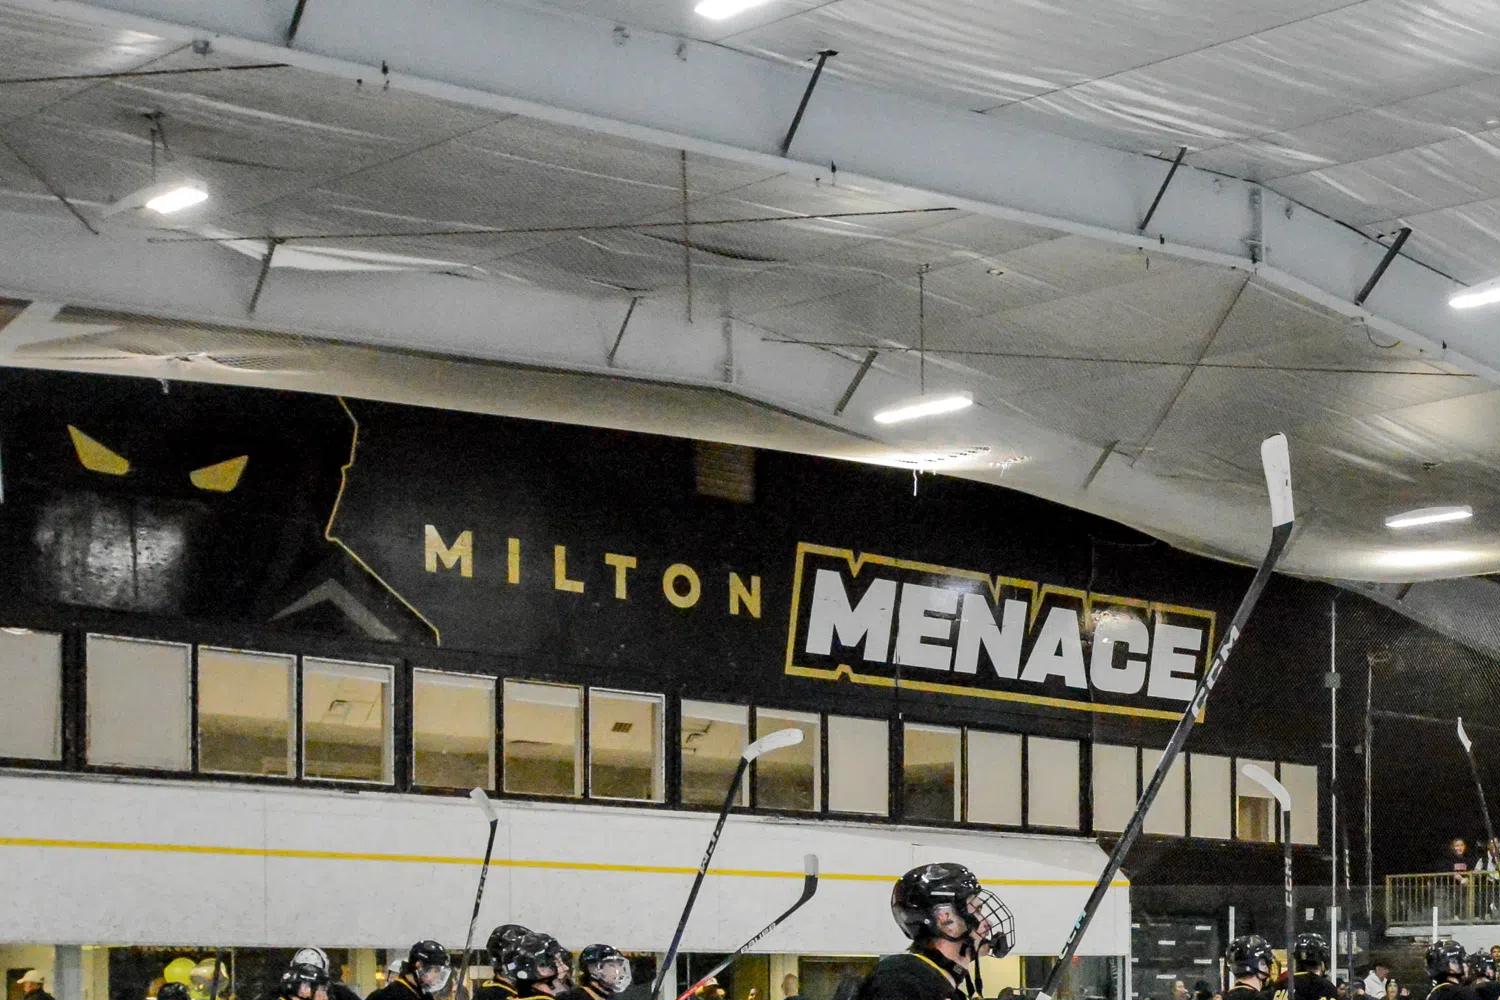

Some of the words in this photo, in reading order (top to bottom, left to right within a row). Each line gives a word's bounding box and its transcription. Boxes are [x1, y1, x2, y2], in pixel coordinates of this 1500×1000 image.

[425, 524, 761, 619] MILTON
[805, 569, 1202, 701] MENACE
[1192, 625, 1240, 718] CCM
